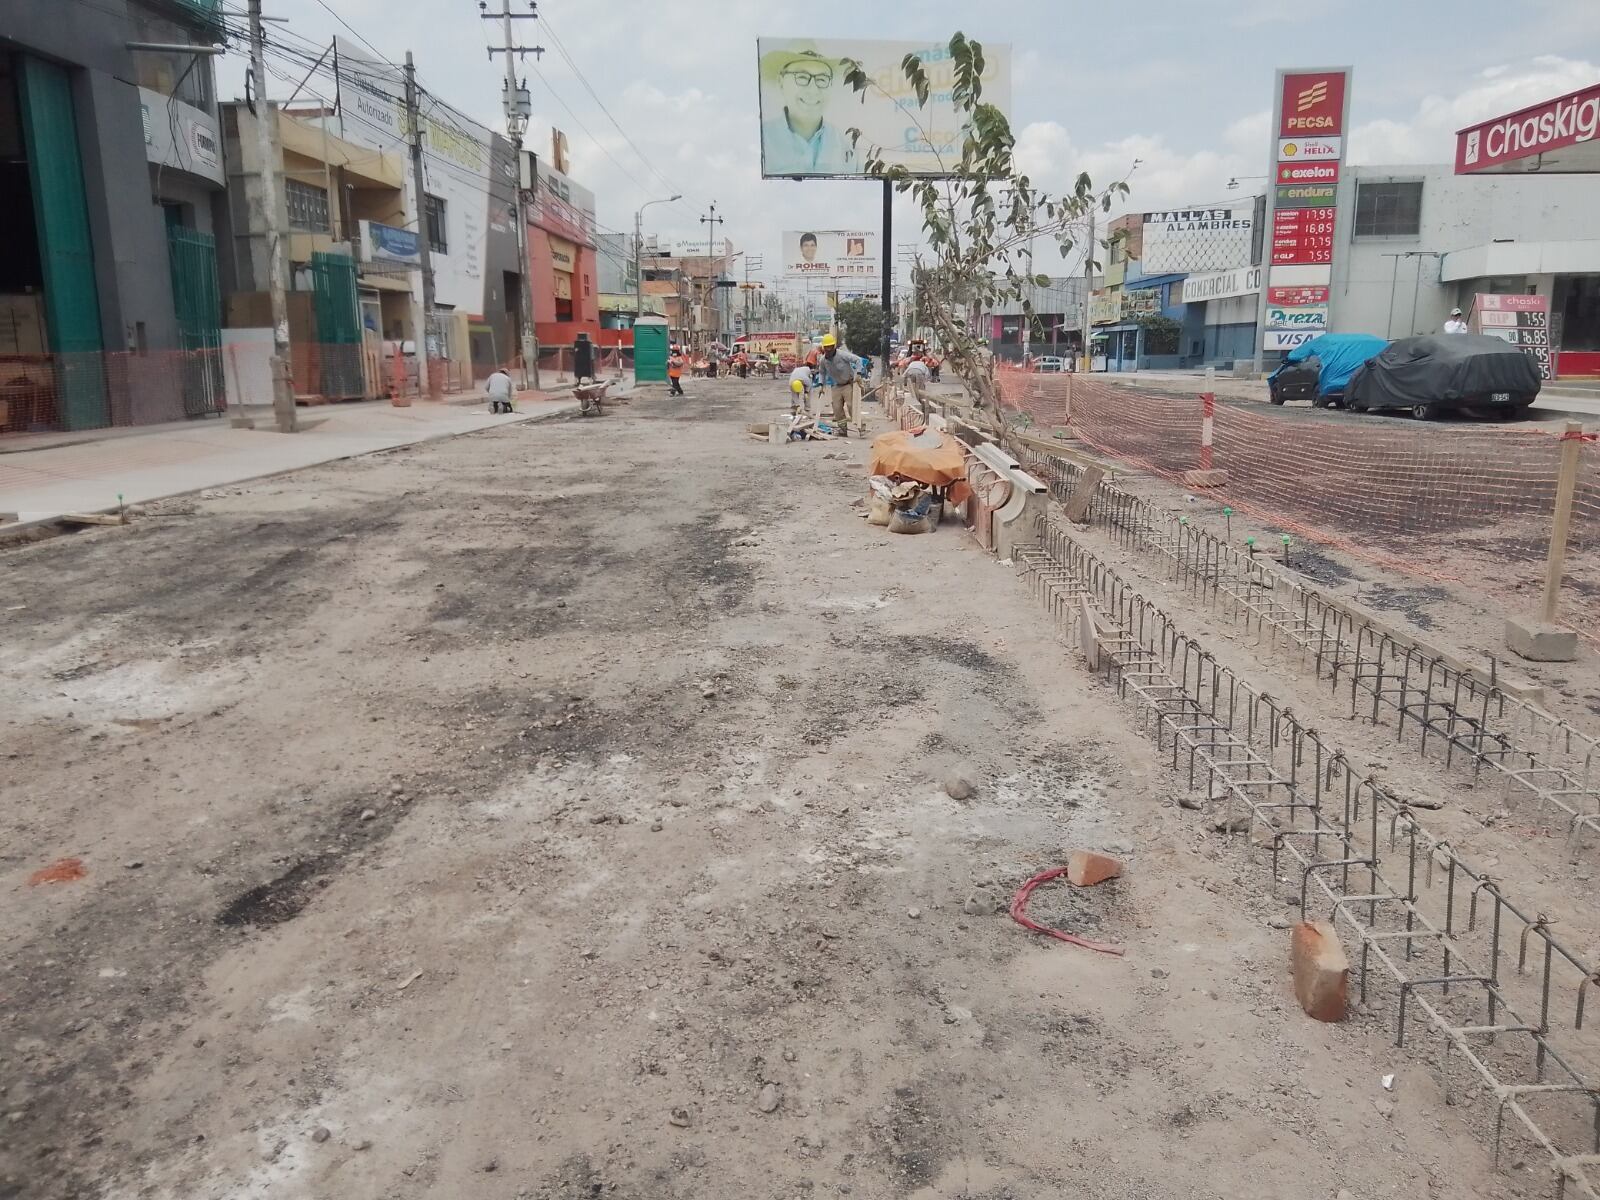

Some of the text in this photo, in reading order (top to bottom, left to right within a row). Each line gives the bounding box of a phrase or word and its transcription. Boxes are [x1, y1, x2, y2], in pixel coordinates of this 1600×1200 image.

[357, 96, 393, 127] Autorizado
[1287, 116, 1334, 129] PECSA
[1304, 145, 1335, 155] HELIX
[1291, 166, 1335, 179] exelon
[1287, 186, 1334, 198] endura
[1150, 210, 1226, 223] MALLAS
[1306, 209, 1333, 221] 17.95
[1166, 219, 1251, 232] ALAMBRES
[1305, 223, 1332, 235] 16.85
[1304, 237, 1331, 248] 17.75
[1309, 250, 1330, 262] 7.55
[1184, 272, 1239, 300] COMERCIAL
[1524, 312, 1545, 327] 7.55
[1277, 333, 1314, 345] VISA
